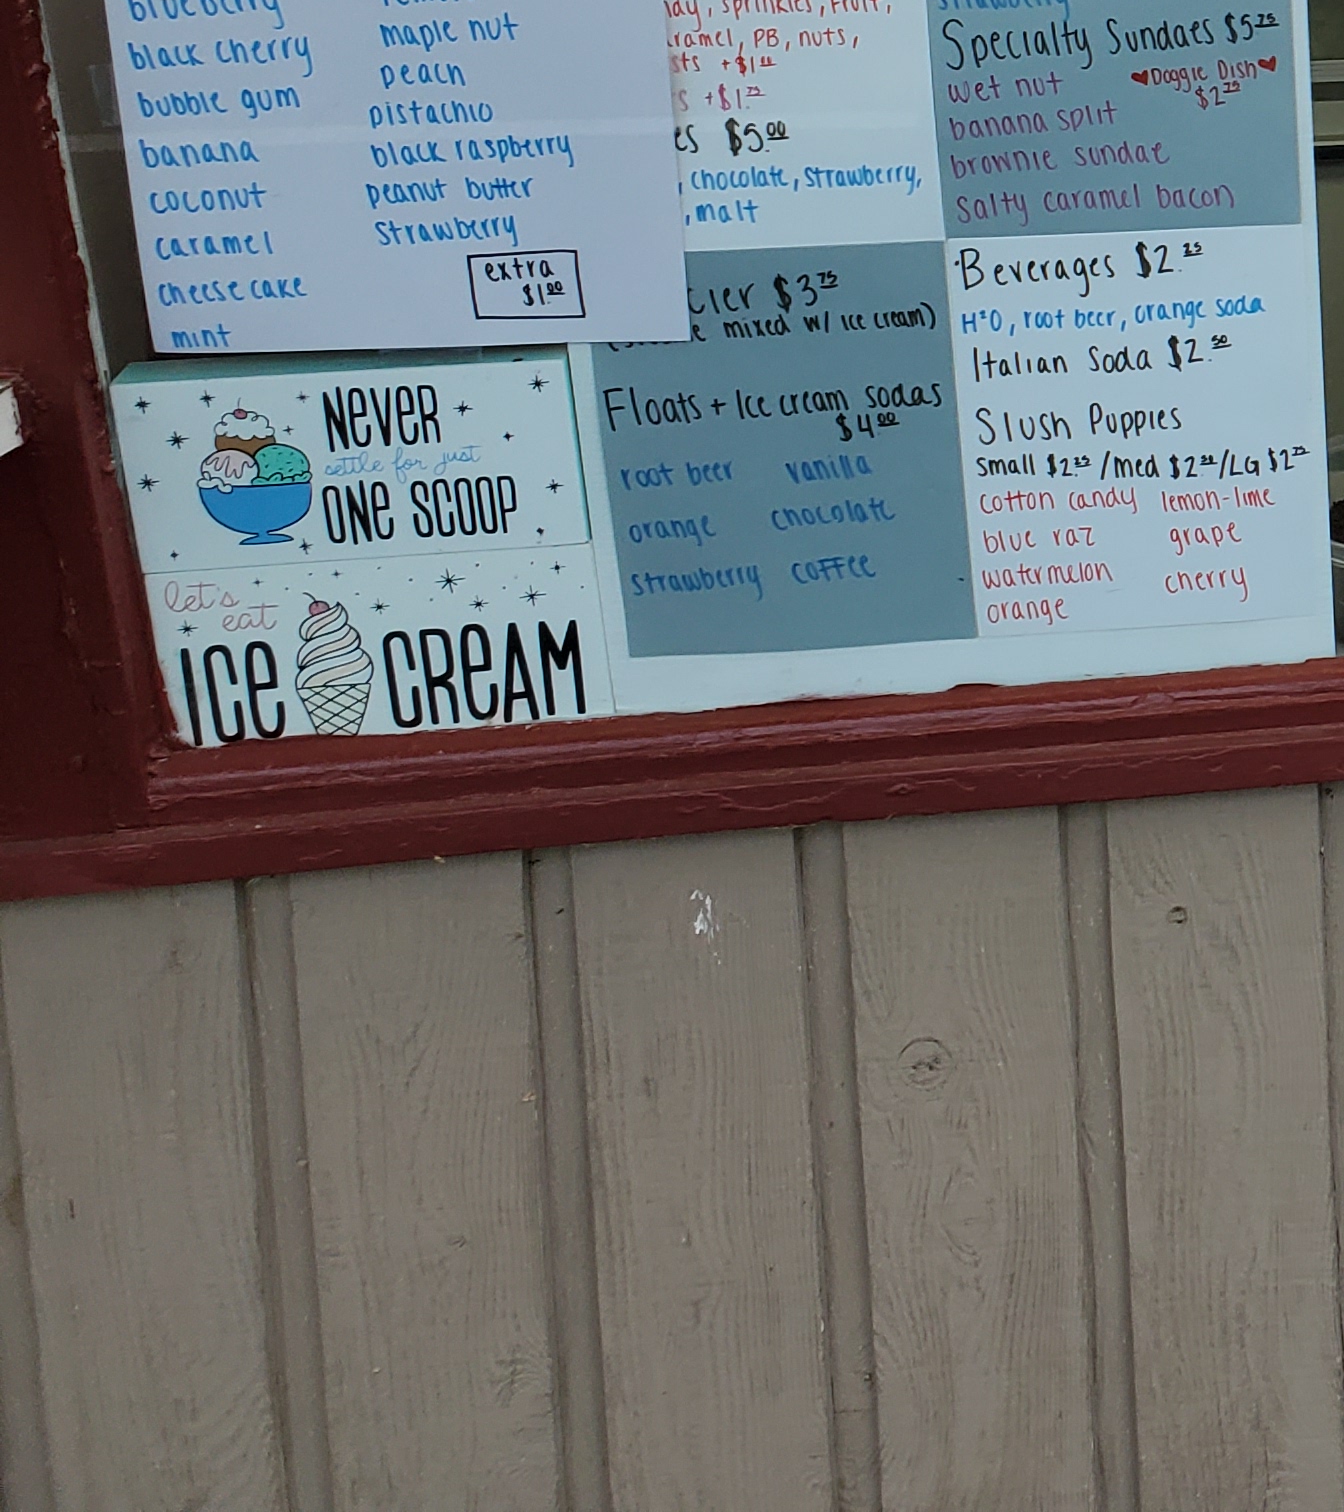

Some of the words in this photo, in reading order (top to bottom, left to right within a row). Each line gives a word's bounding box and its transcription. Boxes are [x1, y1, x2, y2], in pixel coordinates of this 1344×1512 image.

[379, 20, 458, 50] maple
[470, 18, 520, 42] nut
[942, 17, 1093, 71] Specialty
[1107, 17, 1215, 56] Sundaes
[127, 42, 203, 71] black
[216, 34, 313, 77] cherry
[137, 92, 226, 119] bubble
[241, 89, 300, 119] gum
[368, 101, 494, 136] pistachio
[949, 114, 1048, 142] banana
[1058, 99, 1119, 129] split
[139, 138, 259, 170] banana
[370, 142, 446, 168] black
[457, 132, 574, 167] raspberry
[950, 149, 1058, 179] brownie
[1074, 141, 1171, 167] sundae
[150, 188, 268, 215] coconut
[155, 230, 275, 259] caramel
[484, 258, 555, 281] extra
[960, 246, 1116, 295] Beverages
[171, 324, 233, 347] mint
[972, 345, 1068, 383] Italian
[1088, 340, 1153, 372] Soda
[977, 408, 1072, 445] Slush
[1090, 403, 1182, 440] Puppies
[324, 450, 382, 477] settle
[391, 446, 427, 483] for
[434, 445, 481, 473] just
[785, 456, 872, 485] vanilla
[410, 475, 518, 538] SCOOP
[980, 487, 1057, 516] cotton
[1069, 485, 1138, 514] candy
[981, 561, 1114, 591] watermelon
[1165, 565, 1250, 601] cherry
[163, 579, 239, 613] let's
[222, 603, 278, 632] eat
